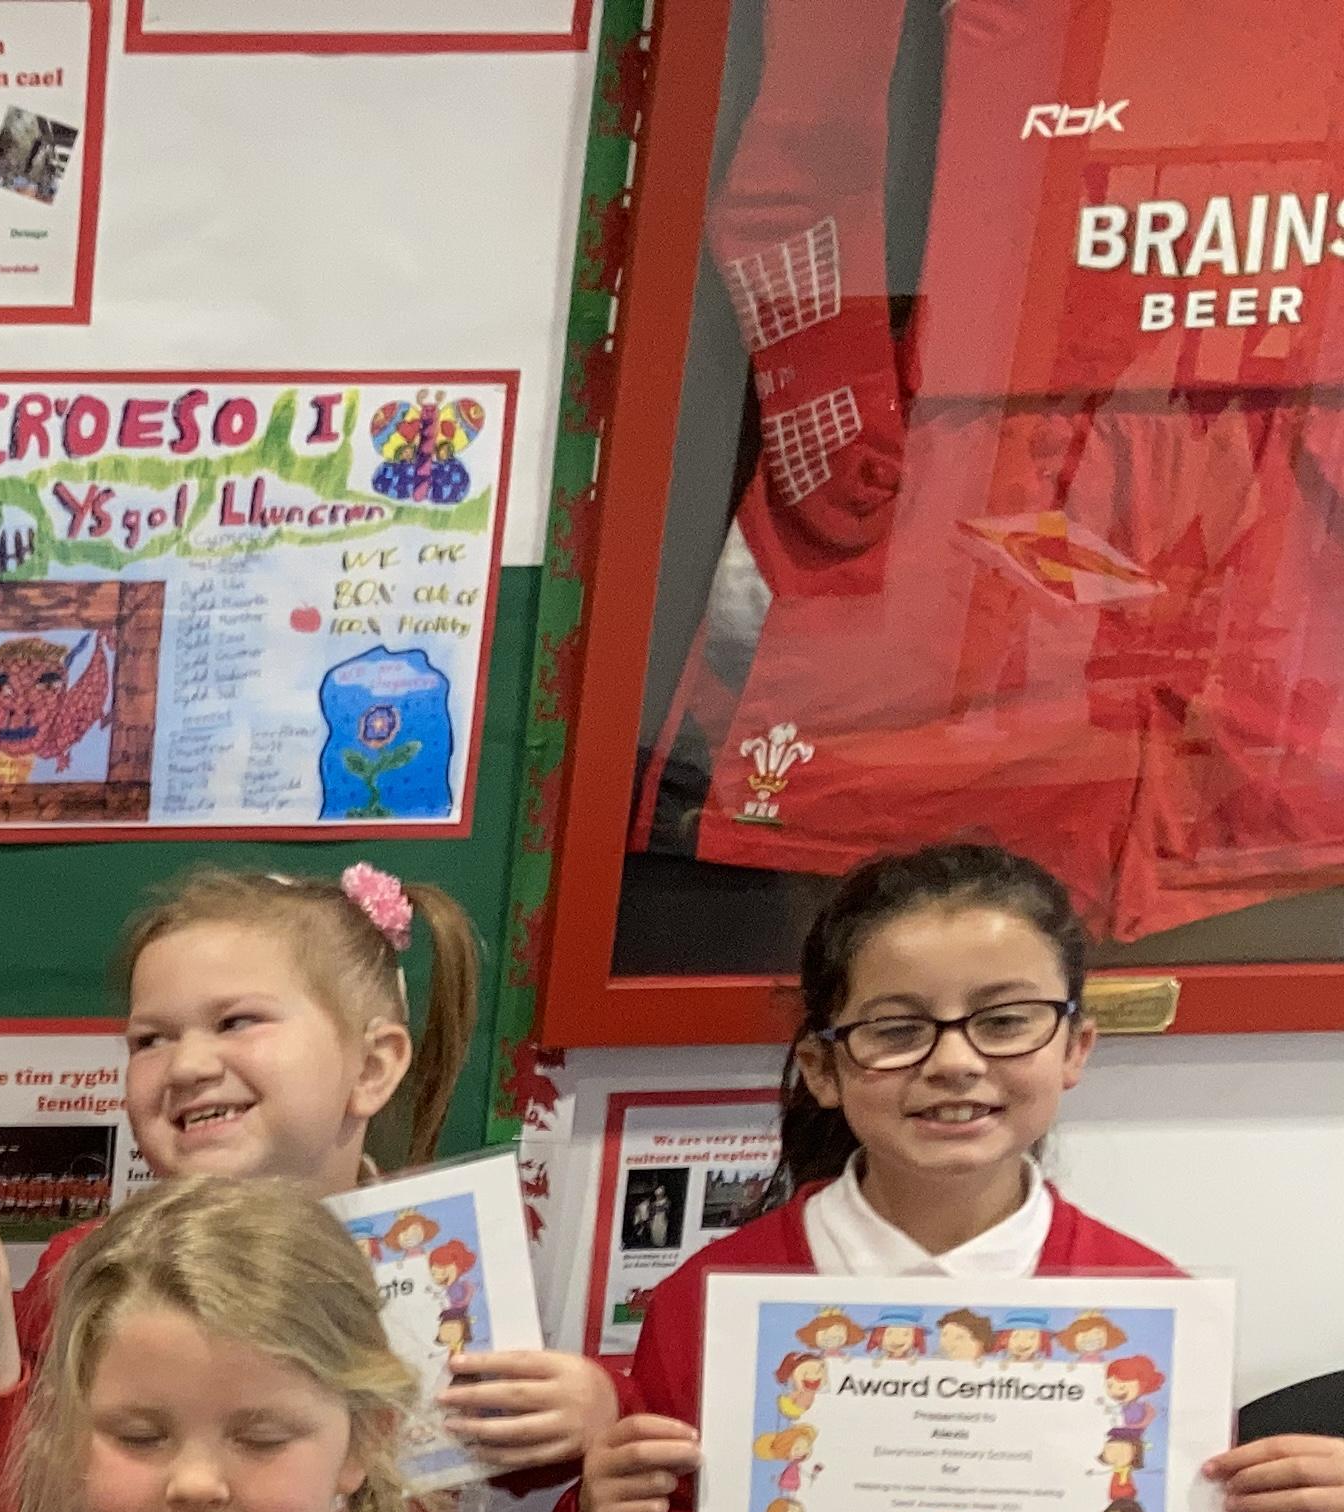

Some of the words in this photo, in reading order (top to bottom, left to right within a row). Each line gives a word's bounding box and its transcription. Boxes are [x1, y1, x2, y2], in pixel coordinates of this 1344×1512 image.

[16, 68, 63, 87] cael
[1140, 286, 1304, 332] BEER
[306, 392, 343, 445] I
[59, 1067, 119, 1088] rygbi
[653, 1135, 673, 1146] We
[679, 1136, 701, 1145] are
[706, 1134, 737, 1146] very
[683, 1152, 710, 1162] and
[837, 1375, 930, 1398] Award
[936, 1376, 1085, 1401] Certificate
